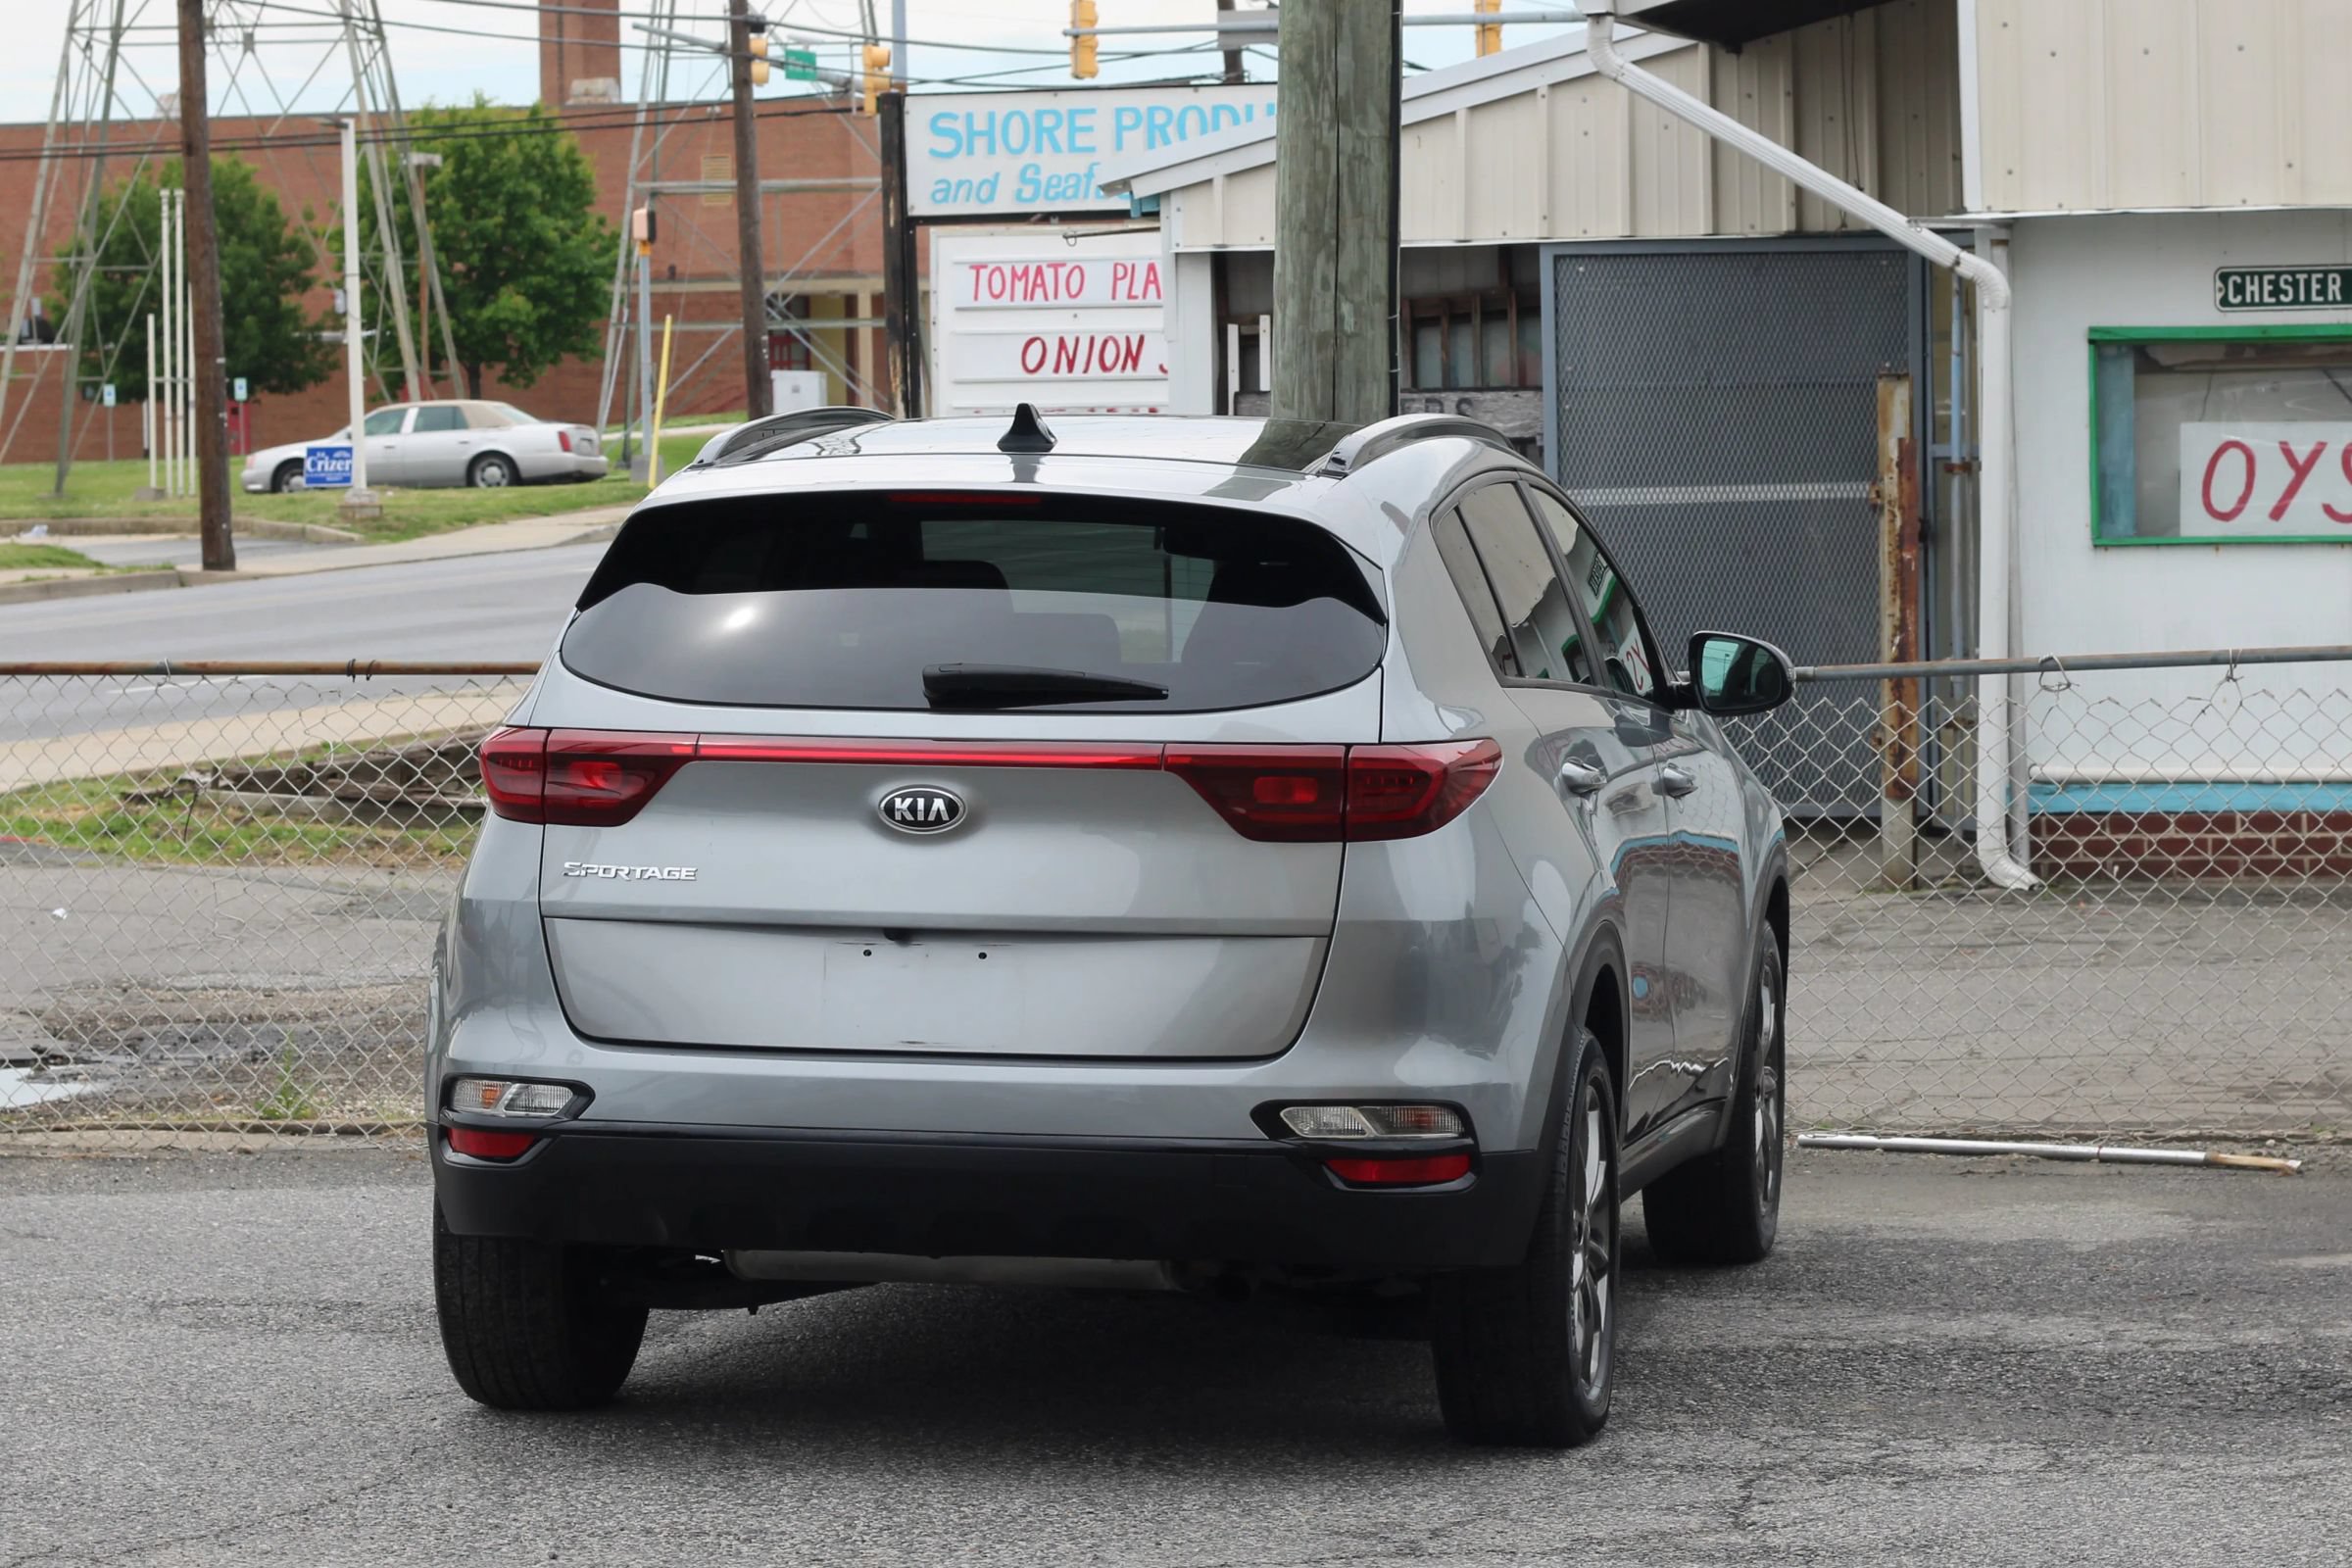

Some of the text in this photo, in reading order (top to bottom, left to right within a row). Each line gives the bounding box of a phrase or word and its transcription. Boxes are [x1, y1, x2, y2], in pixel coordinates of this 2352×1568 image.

[928, 107, 1097, 159] SHORE
[930, 161, 1129, 206] and Seaf
[968, 262, 1086, 303] TOMATO
[2228, 272, 2343, 305] CHESTER
[1020, 333, 1146, 374] ONION
[306, 455, 353, 472] Crizer
[894, 797, 951, 821] KIA
[562, 860, 699, 882] SPORTAGE
